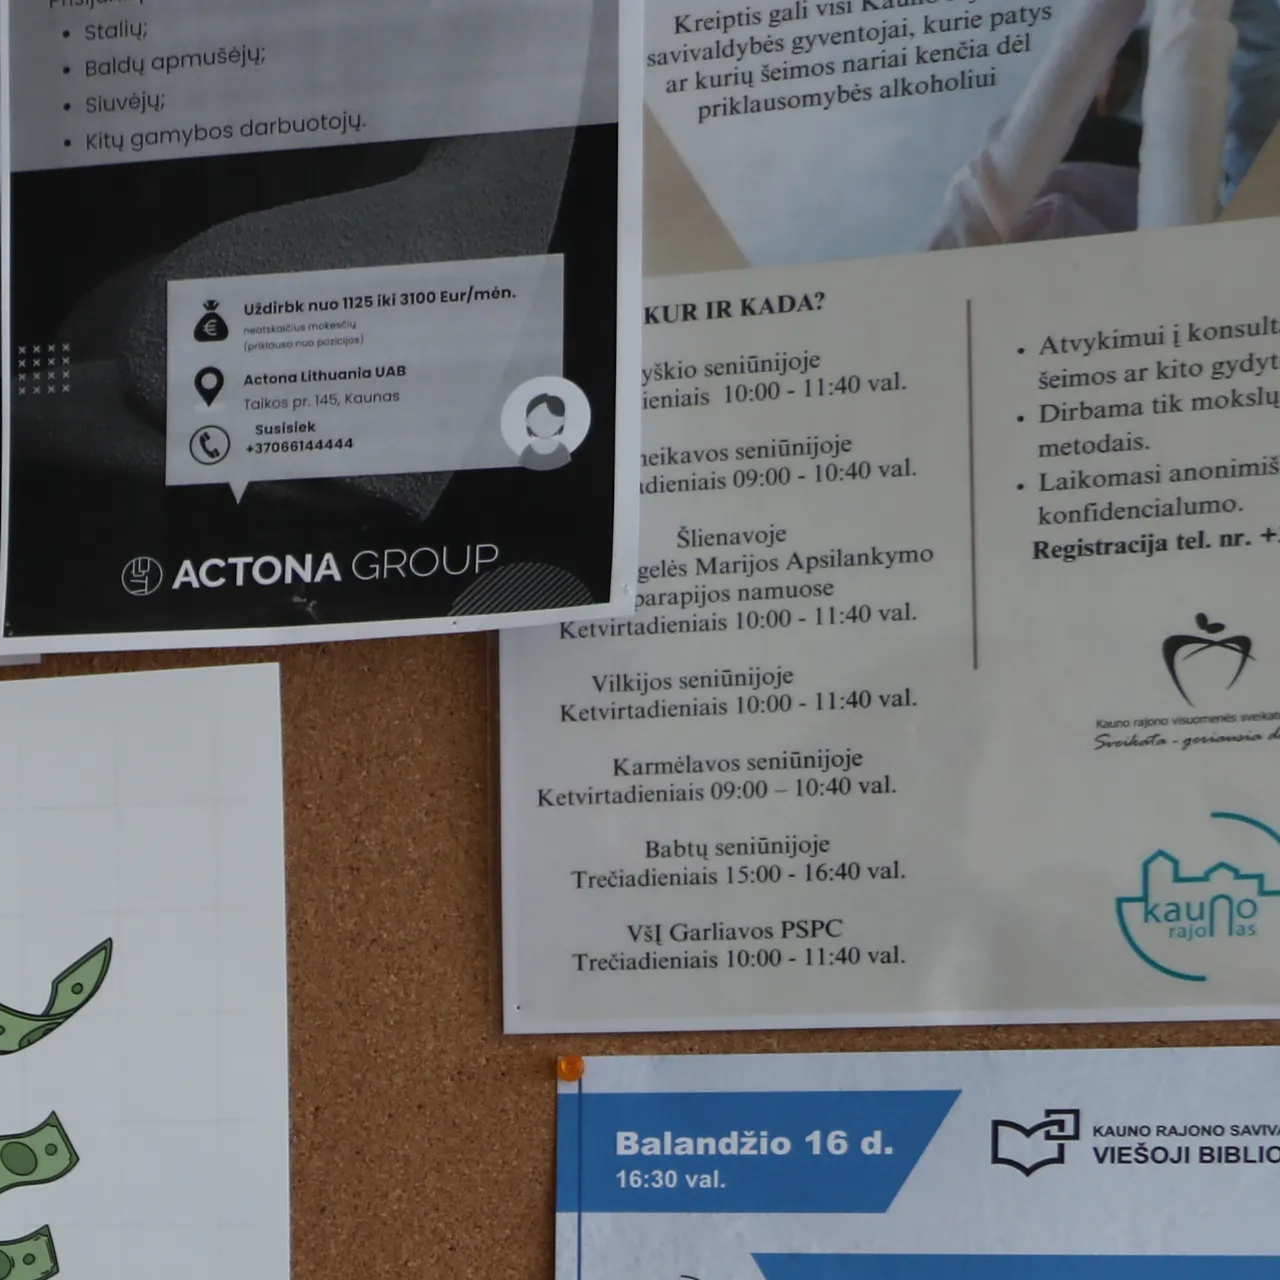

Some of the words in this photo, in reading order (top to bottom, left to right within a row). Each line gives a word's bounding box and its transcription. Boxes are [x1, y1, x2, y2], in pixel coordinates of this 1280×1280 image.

[85, 20, 147, 40] Stalių;
[675, 10, 762, 34] Kreiptis
[768, 1, 808, 28] gali
[647, 35, 787, 70] savivaldybės
[791, 24, 915, 55] gyventojai,
[924, 10, 983, 34] kurie
[990, 6, 1052, 32] patys
[85, 56, 144, 77] Baldų
[666, 78, 688, 93] ar
[696, 66, 754, 90] kurių
[761, 60, 835, 82] šeimos
[842, 47, 907, 73] nariai
[916, 39, 989, 65] kenčia
[997, 33, 1030, 55] dėl
[698, 83, 873, 124] priklausomybės
[879, 67, 996, 99] alkoholiui
[86, 132, 124, 152] Kitų
[130, 124, 233, 152] gamybos
[240, 111, 366, 137] darbuotojų.
[244, 300, 304, 316] Uždirbk
[308, 301, 339, 312] nuo
[343, 295, 373, 309] 1125
[377, 293, 396, 307] iki
[400, 291, 436, 305] 3100
[645, 303, 697, 324] KUR
[707, 300, 732, 319] IR
[741, 291, 825, 316] KADA?
[244, 374, 297, 386] Actona
[301, 367, 371, 382] Lithuania
[375, 365, 406, 378] UAB
[244, 397, 288, 410] Taikos
[291, 396, 311, 412] pr.
[315, 393, 340, 406] 145,
[345, 392, 400, 404] Kaunas
[255, 421, 316, 435] Susisiek
[246, 438, 353, 454] +37066144444
[1038, 432, 1150, 458] metodais.
[1038, 496, 1244, 525] konfidencialumo.
[677, 524, 787, 548] Šlienavoje
[1033, 533, 1168, 563] Registracija
[172, 552, 342, 589] ACTONA
[352, 544, 499, 580] GROUP
[696, 554, 779, 578] Marijos
[786, 546, 934, 574] Apsilankymo
[592, 672, 672, 696] Vilkijos
[679, 666, 794, 690] seniūnijoje
[560, 697, 728, 722] Ketvirtadieniais
[738, 694, 792, 714] 10:00
[817, 690, 872, 710] 11:40
[878, 688, 917, 707] val.
[613, 755, 741, 776] Karmėlavos
[747, 748, 863, 773] seniūnijoje
[669, 922, 774, 942] Garliavos
[782, 919, 843, 939] PSPC
[616, 1131, 791, 1156] Balandžio
[805, 1130, 848, 1155] 16
[861, 1130, 893, 1155] d.
[1093, 1125, 1151, 1137] KAUNO
[1156, 1125, 1225, 1137] RAJONO
[1093, 1142, 1190, 1164] VIEŠOJI
[616, 1170, 677, 1188] 16:30
[685, 1170, 725, 1188] val.
